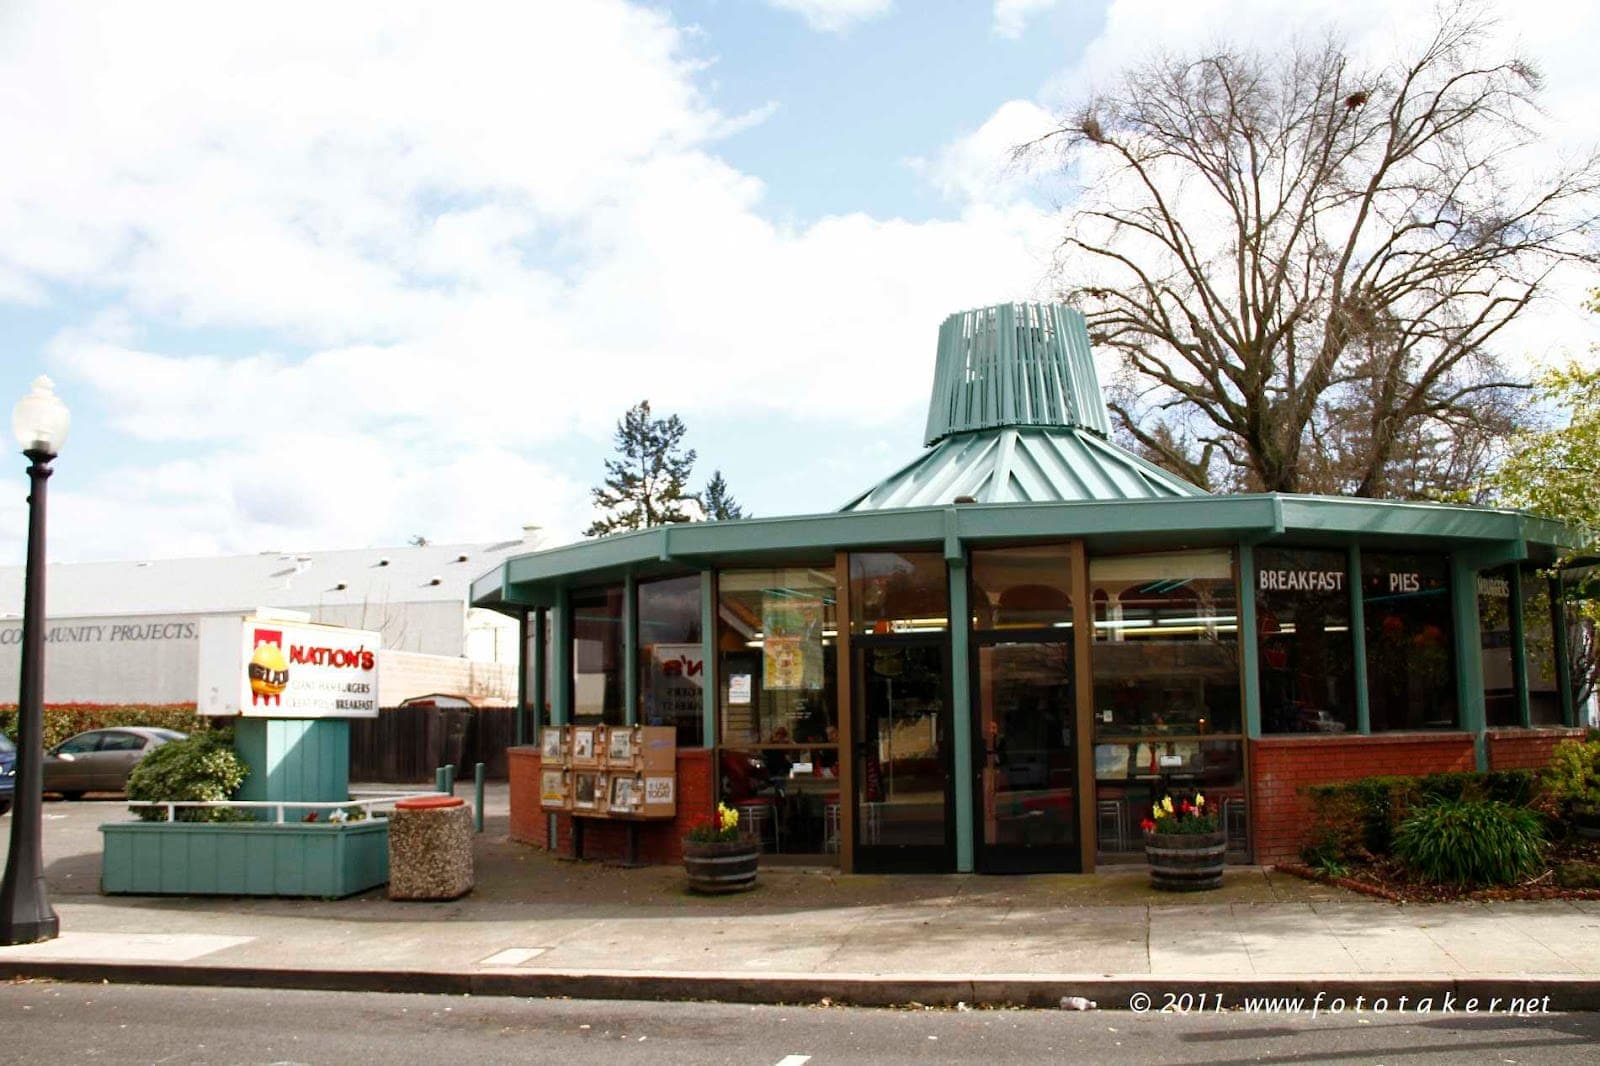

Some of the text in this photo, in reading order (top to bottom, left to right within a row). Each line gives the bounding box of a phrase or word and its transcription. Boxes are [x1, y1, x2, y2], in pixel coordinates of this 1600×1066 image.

[1259, 570, 1343, 590] BREAKFAST
[1389, 572, 1420, 591] PIES
[1, 625, 105, 645] COMUNITY
[289, 644, 374, 671] NATION'S
[336, 699, 374, 710] BREAKFAST
